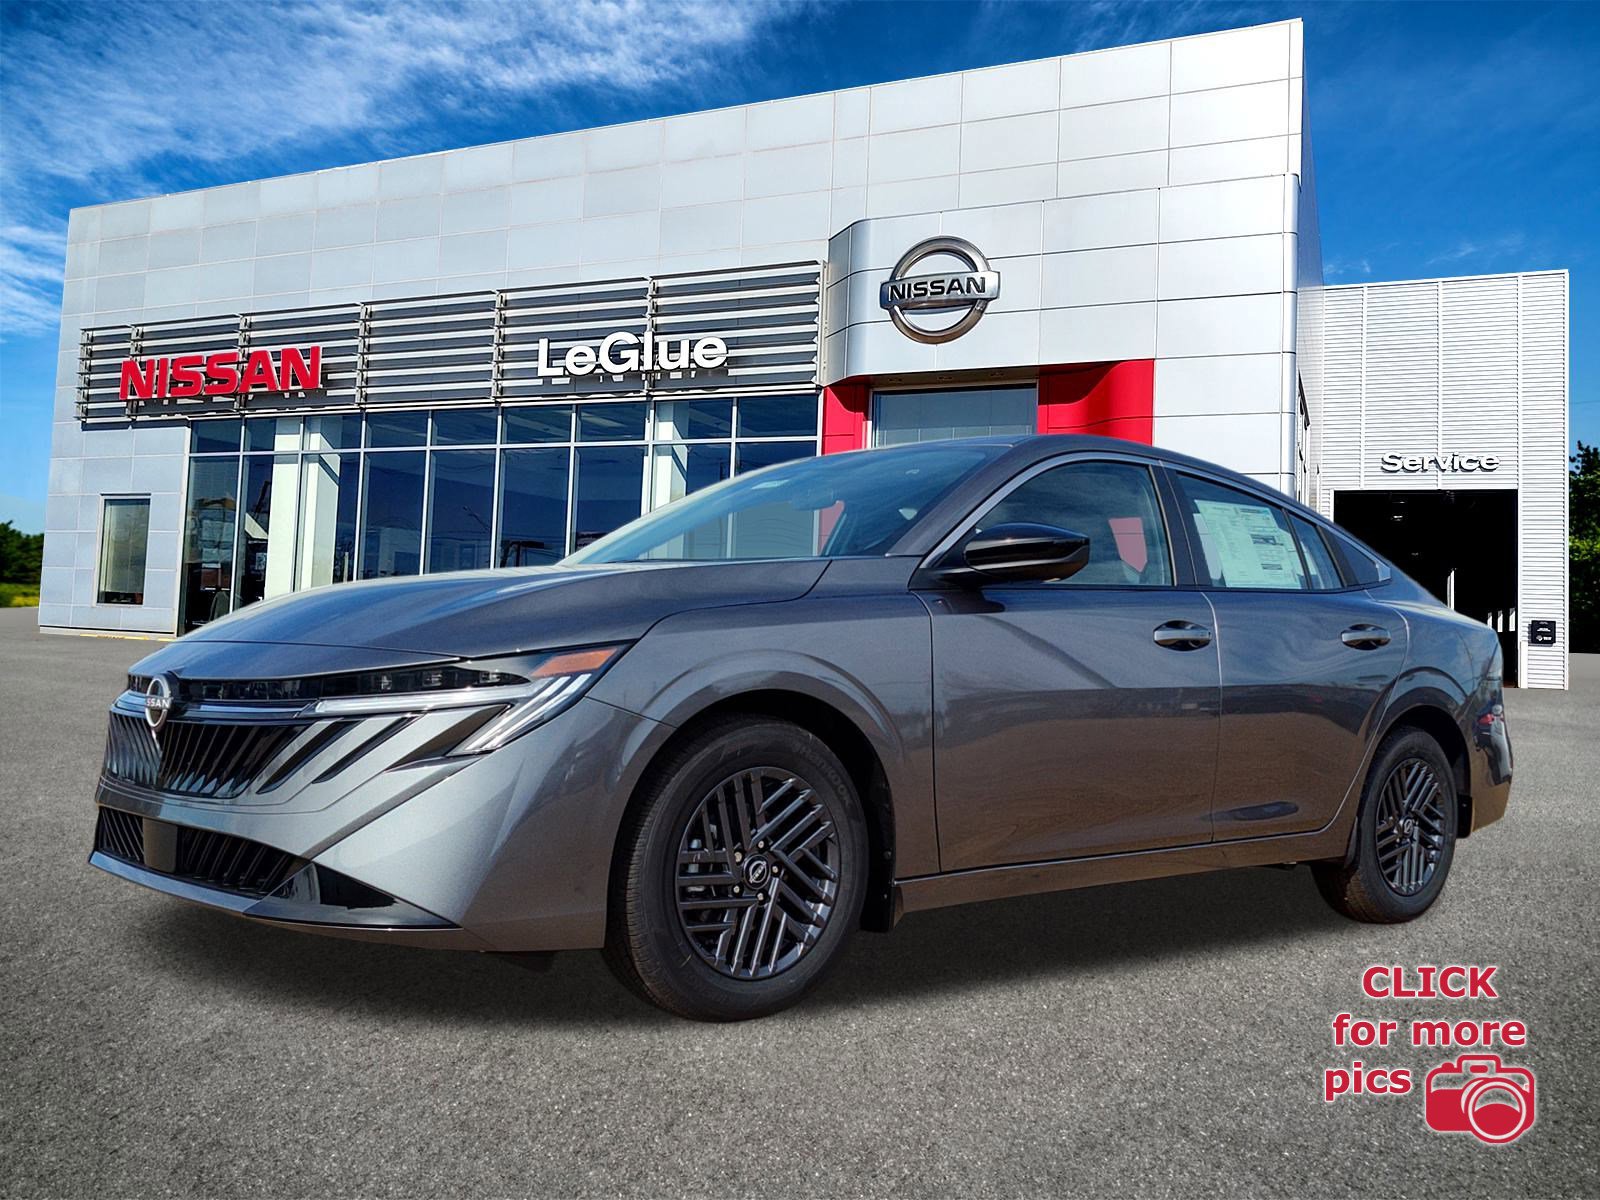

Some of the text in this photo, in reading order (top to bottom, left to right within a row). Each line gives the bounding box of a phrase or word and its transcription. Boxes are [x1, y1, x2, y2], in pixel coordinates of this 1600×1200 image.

[888, 276, 986, 301] NISSAN
[537, 331, 729, 377] LeGlue
[119, 346, 322, 400] NISSAN
[1381, 451, 1500, 473] Service
[146, 698, 169, 708] SSAN
